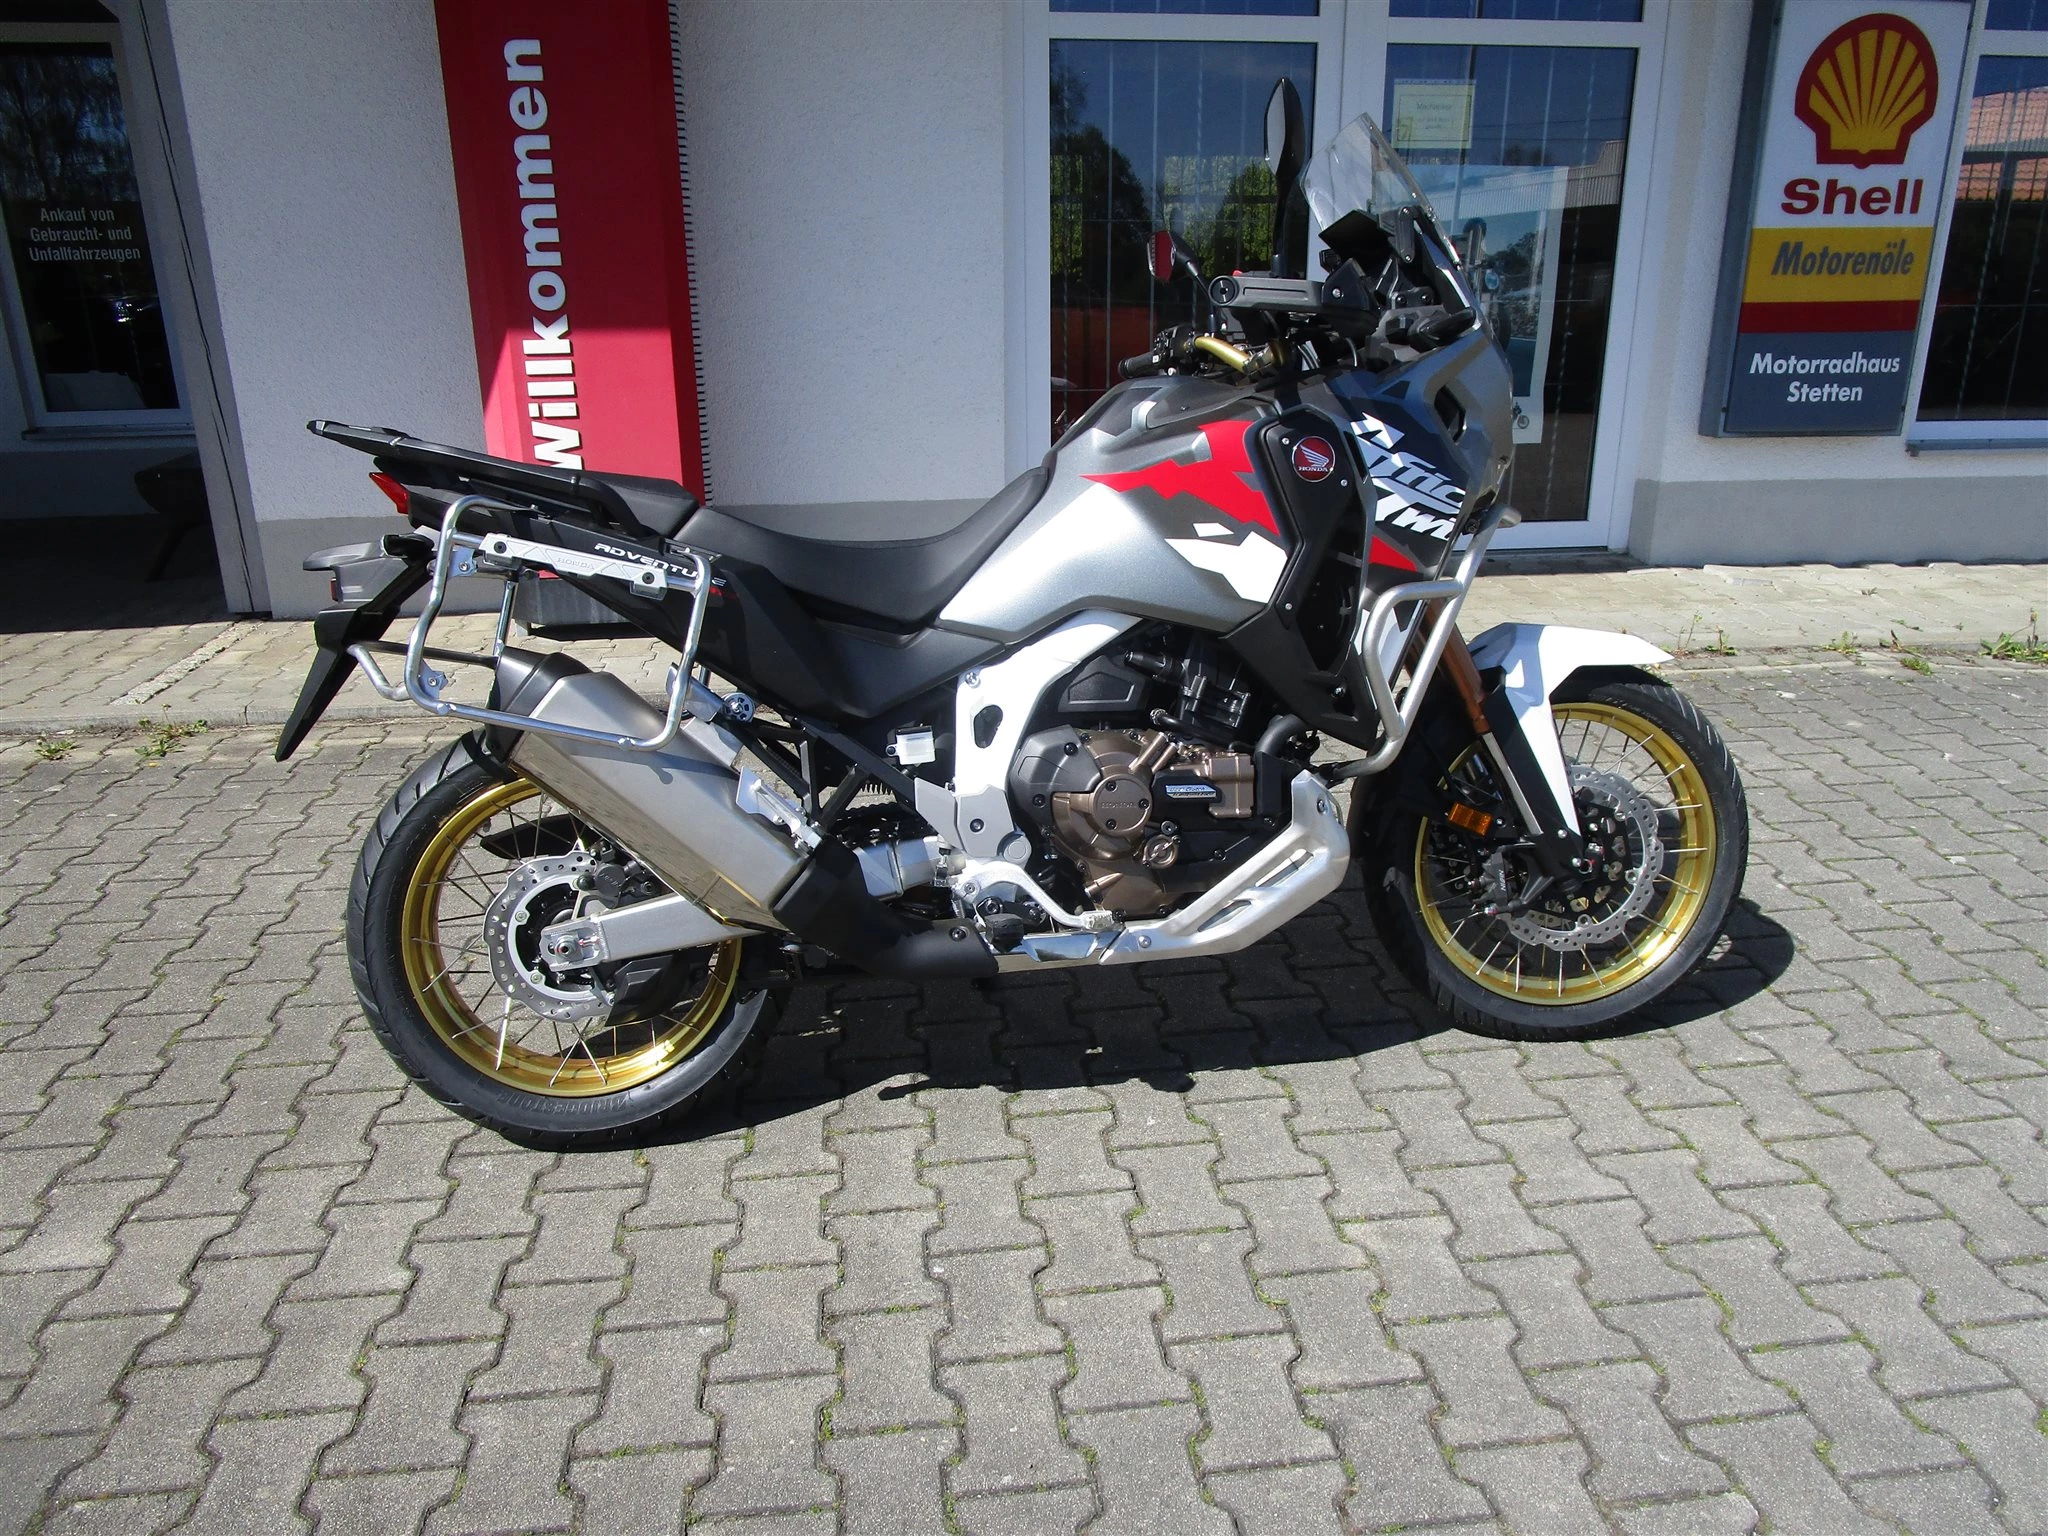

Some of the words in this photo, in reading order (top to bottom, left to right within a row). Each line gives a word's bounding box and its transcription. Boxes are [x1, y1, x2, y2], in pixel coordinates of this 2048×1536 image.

[1781, 178, 1923, 215] Shell
[40, 208, 86, 222] Ankauf
[91, 210, 115, 222] von
[30, 227, 103, 242] Gebraucht-
[108, 226, 132, 240] und
[30, 246, 141, 262] Unfallfahrzeugen
[504, 38, 583, 470] Willkommen
[1771, 239, 1914, 276] Motorenöle
[1750, 351, 1900, 374] Motorradhaus
[1787, 381, 1863, 402] Stetten
[556, 557, 595, 570] HONDA
[594, 542, 727, 586] ADVENTUE
